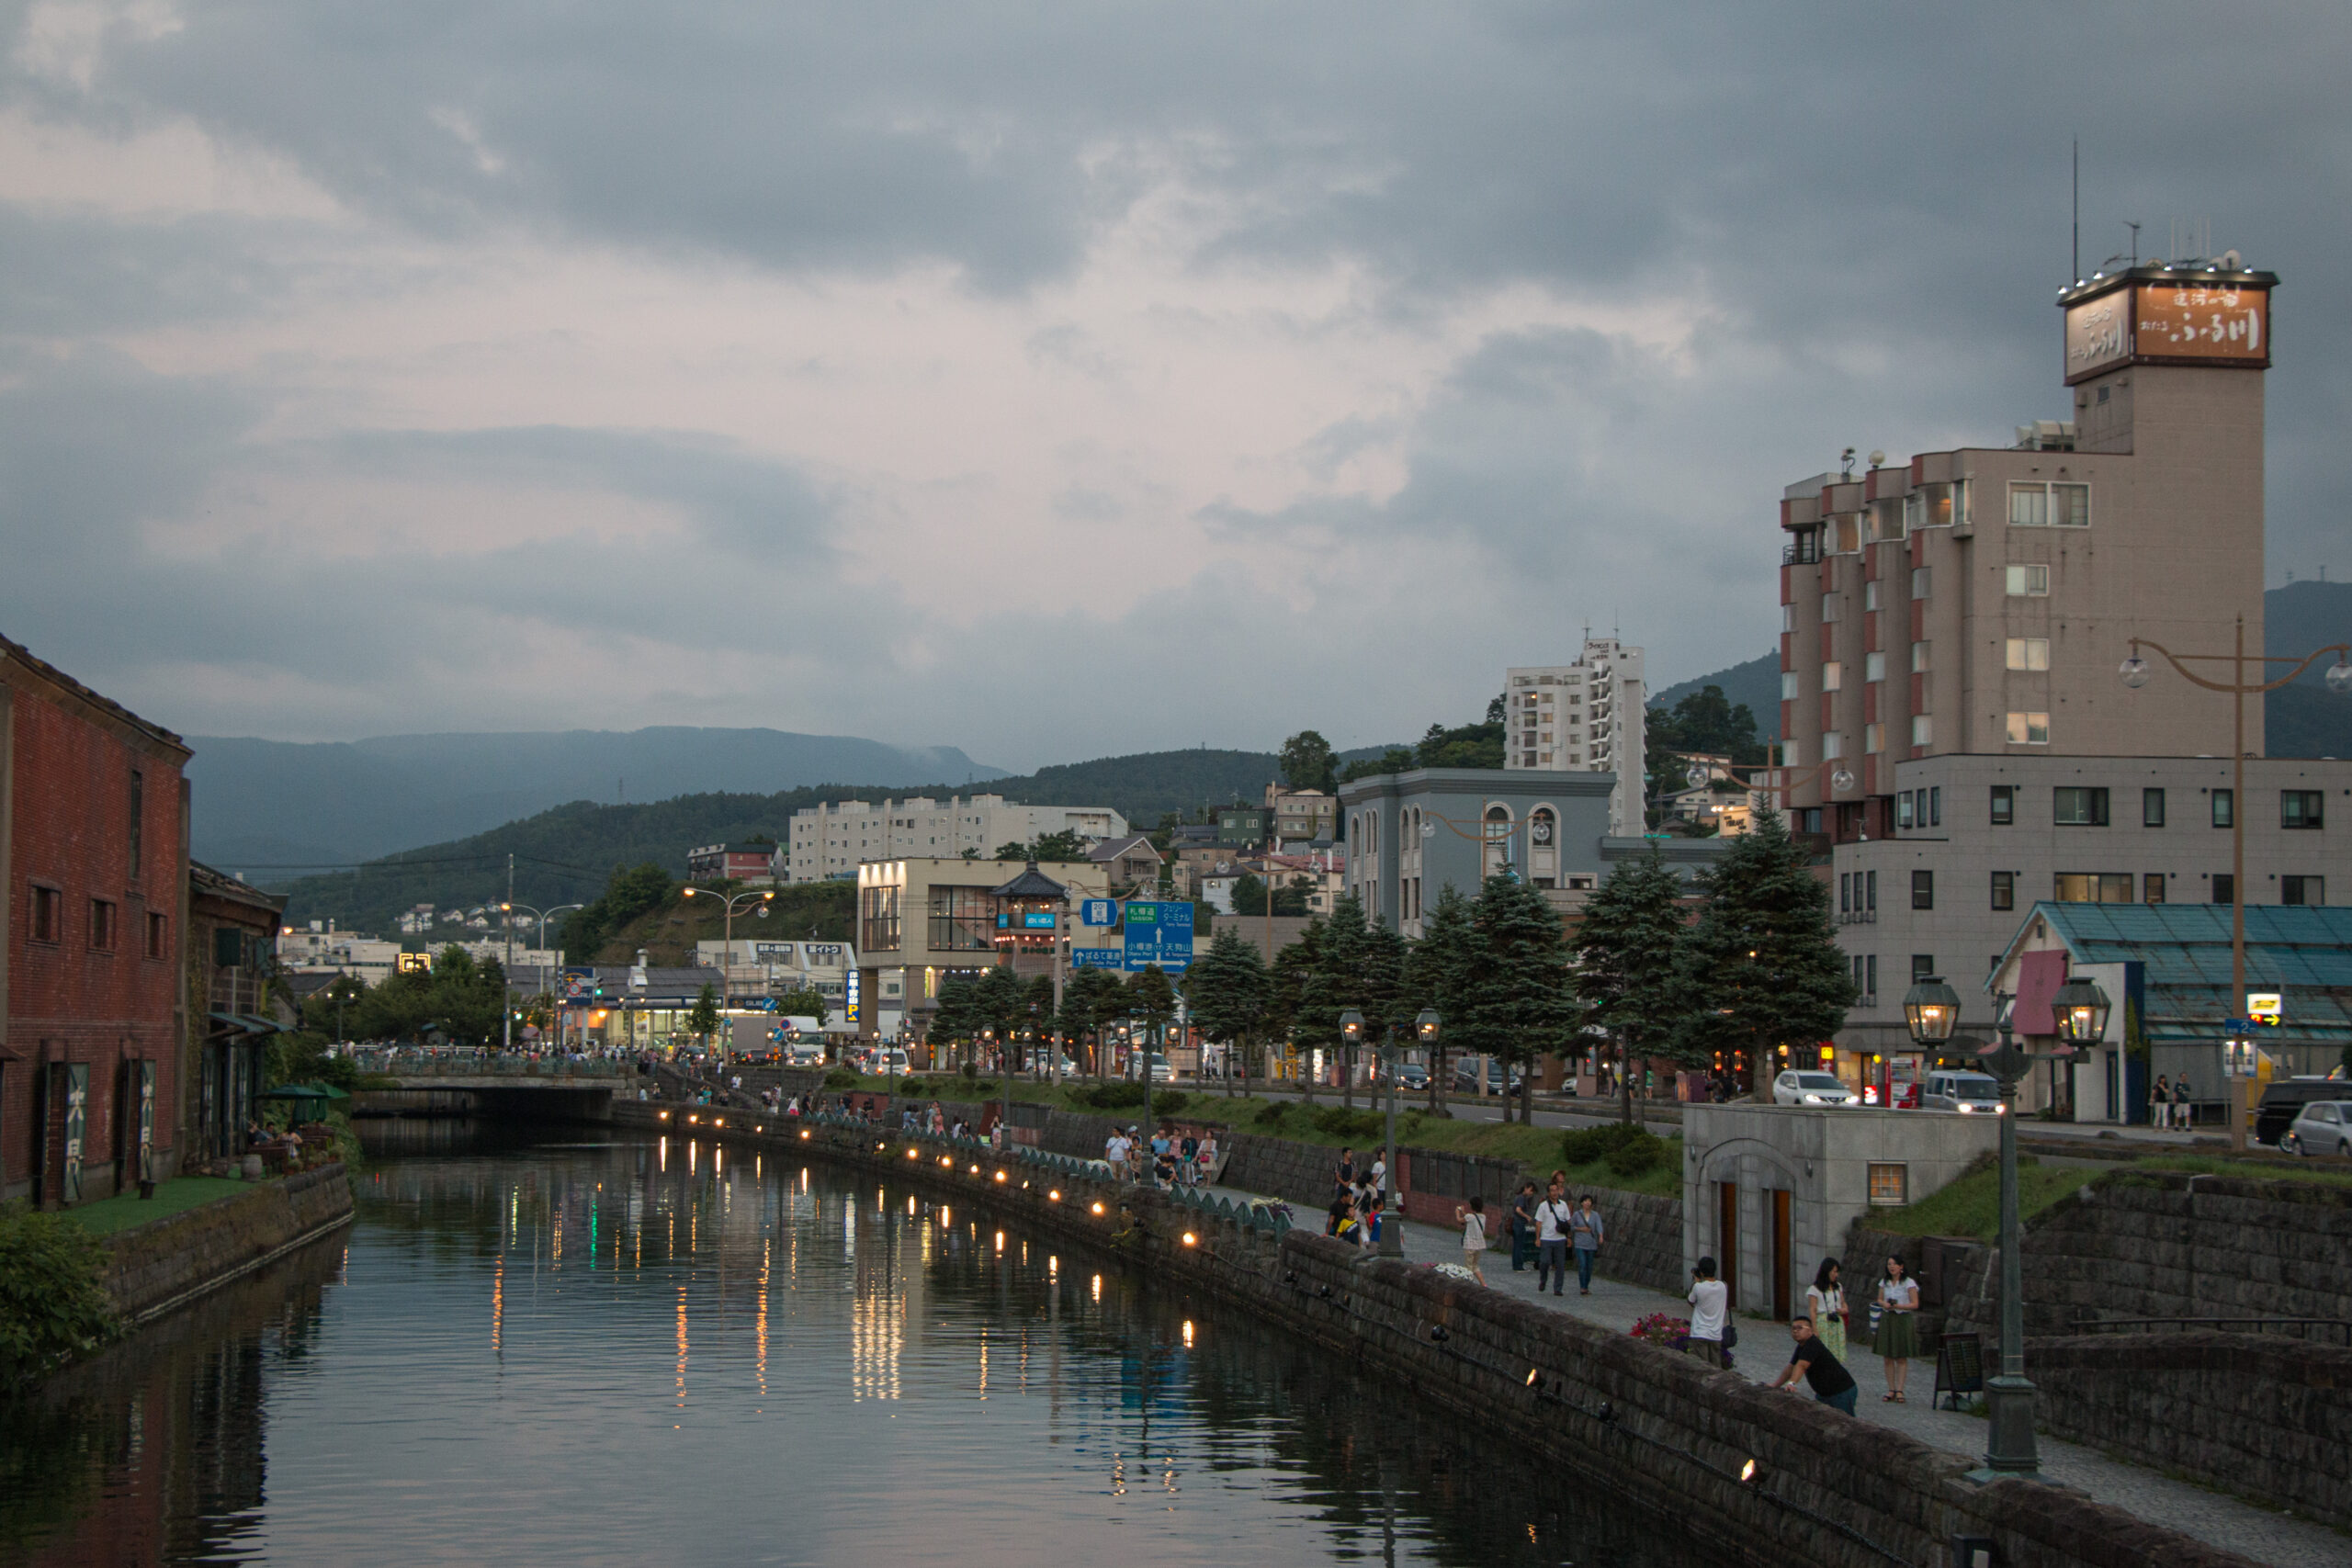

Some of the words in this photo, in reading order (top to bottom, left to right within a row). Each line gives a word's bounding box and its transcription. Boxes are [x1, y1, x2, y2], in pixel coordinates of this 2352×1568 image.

[2169, 308, 2259, 351] ふる川
[2241, 1021, 2249, 1034] 2
